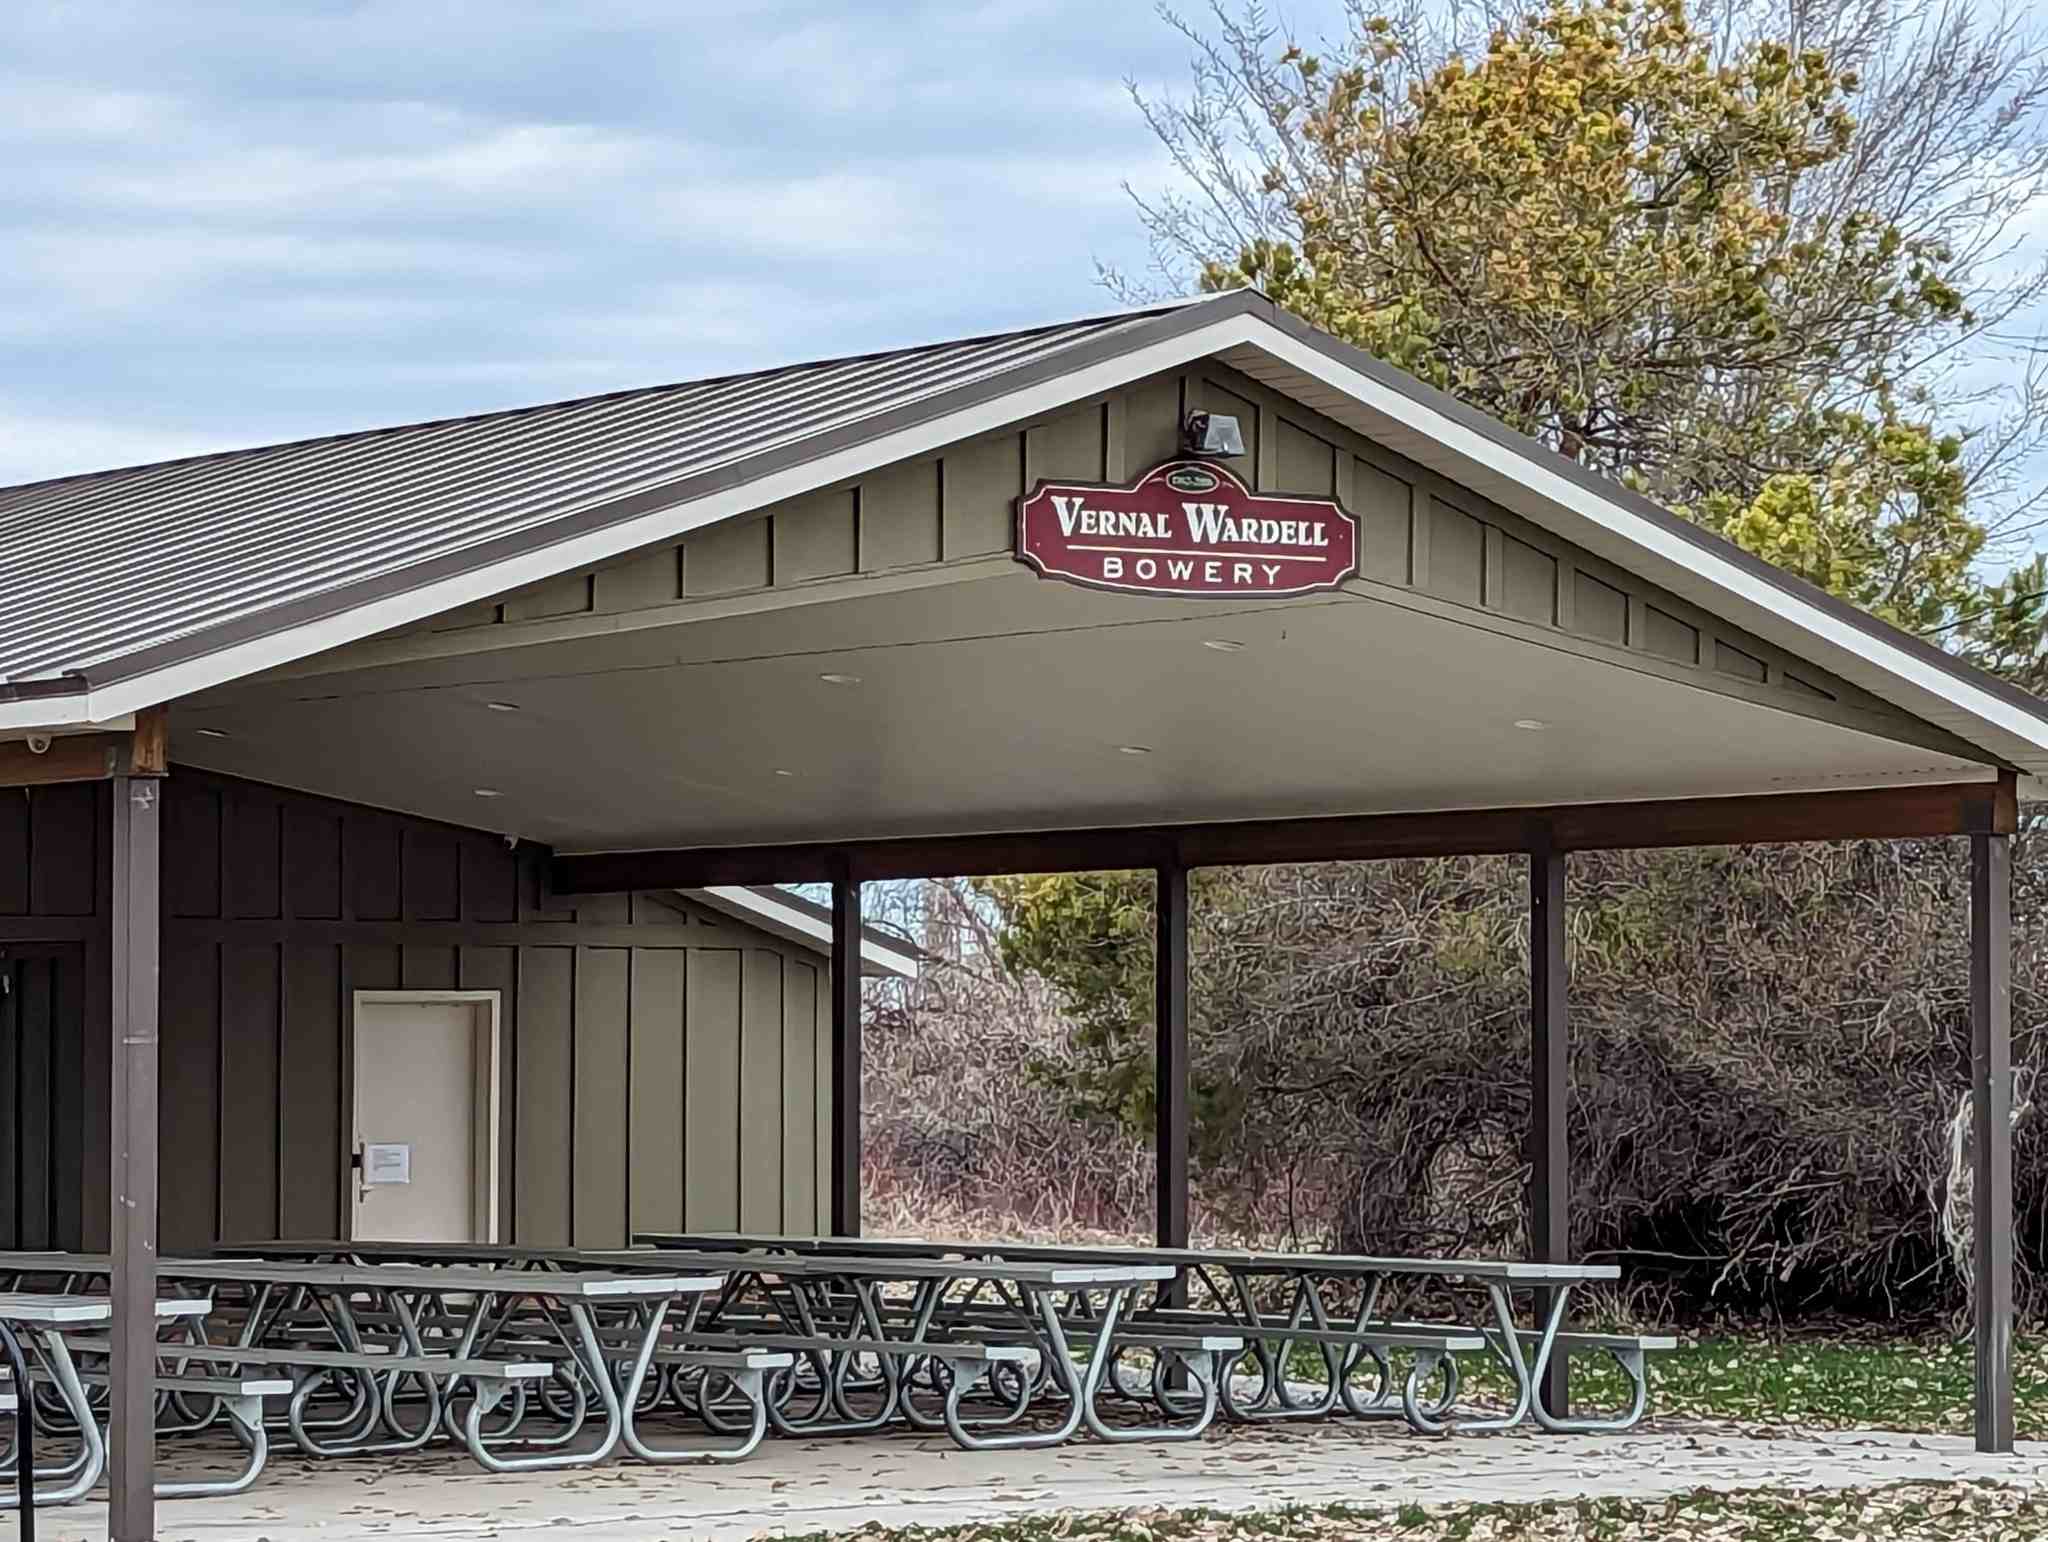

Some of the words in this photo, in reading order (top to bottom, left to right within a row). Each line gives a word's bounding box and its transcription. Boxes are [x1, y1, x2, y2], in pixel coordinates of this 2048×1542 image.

[1051, 496, 1172, 538] VERNAL
[1182, 502, 1328, 546] WARDELL
[1104, 557, 1281, 585] BOWERY
